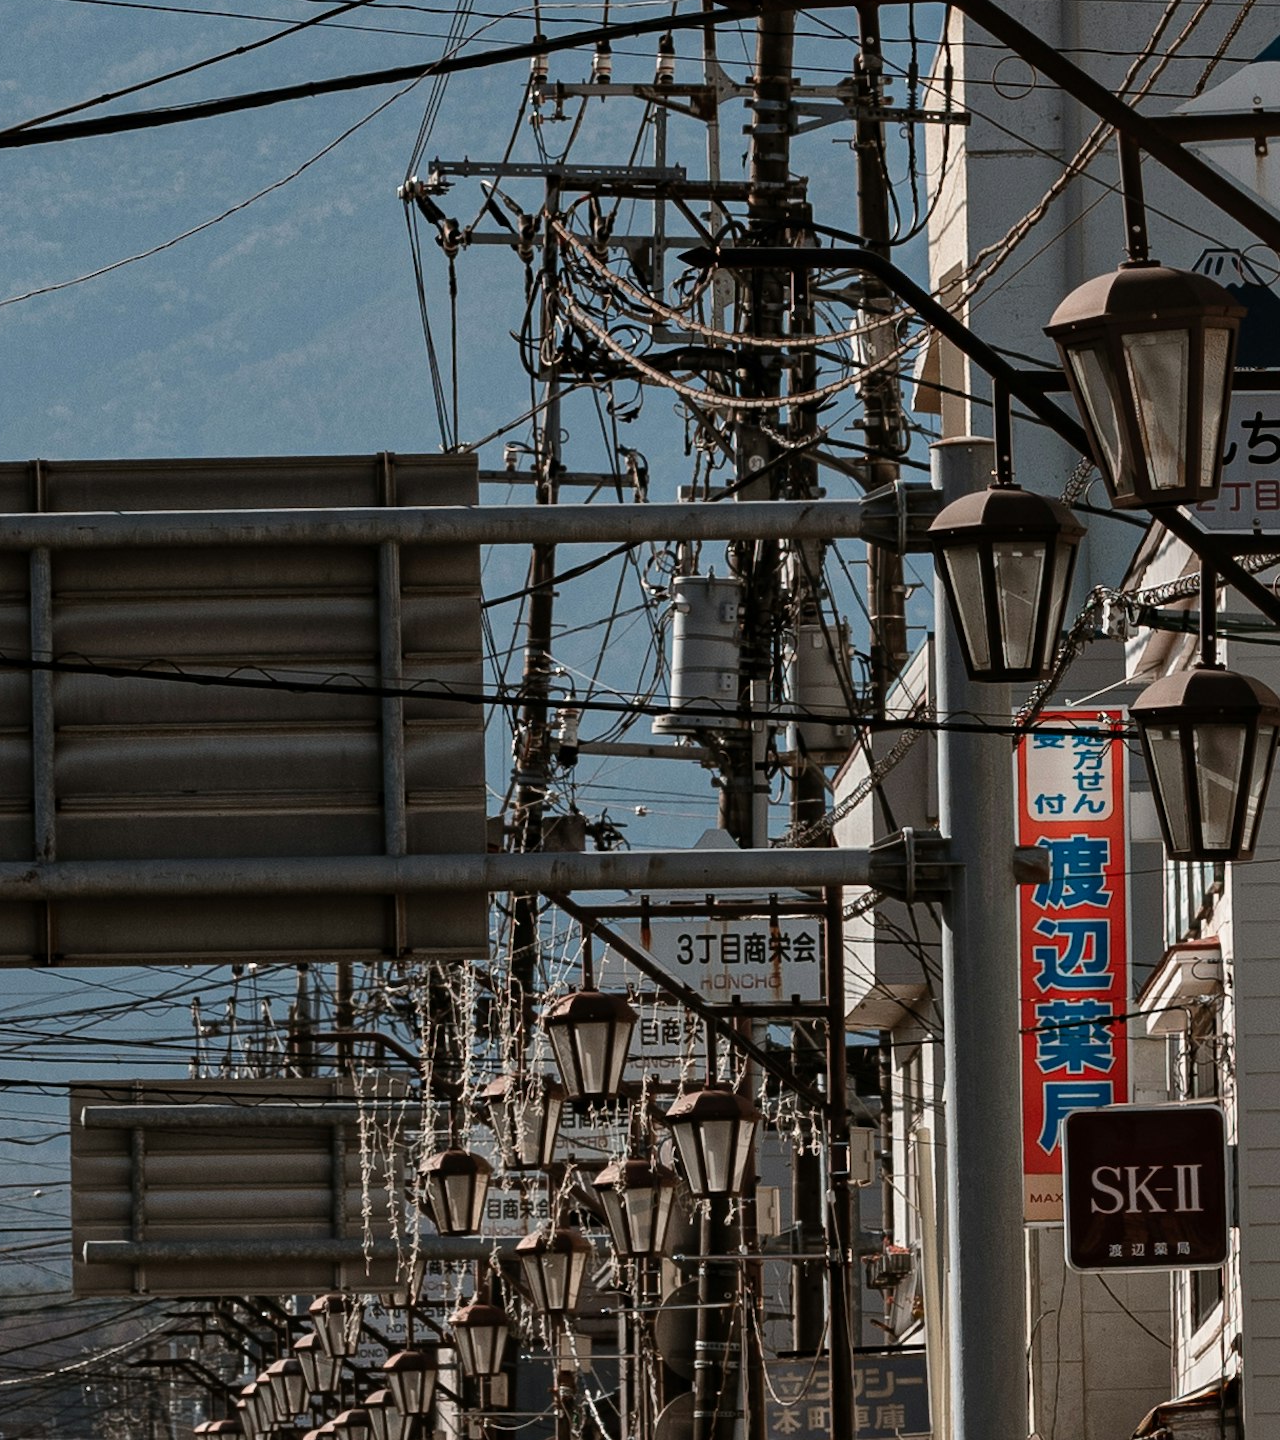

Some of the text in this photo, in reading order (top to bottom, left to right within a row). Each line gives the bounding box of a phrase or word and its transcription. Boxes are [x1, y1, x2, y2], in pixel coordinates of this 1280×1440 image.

[1222, 411, 1280, 466] ち
[677, 932, 816, 965] 3丁目商栄会
[1109, 1241, 1191, 1258] 渡辺薬局
